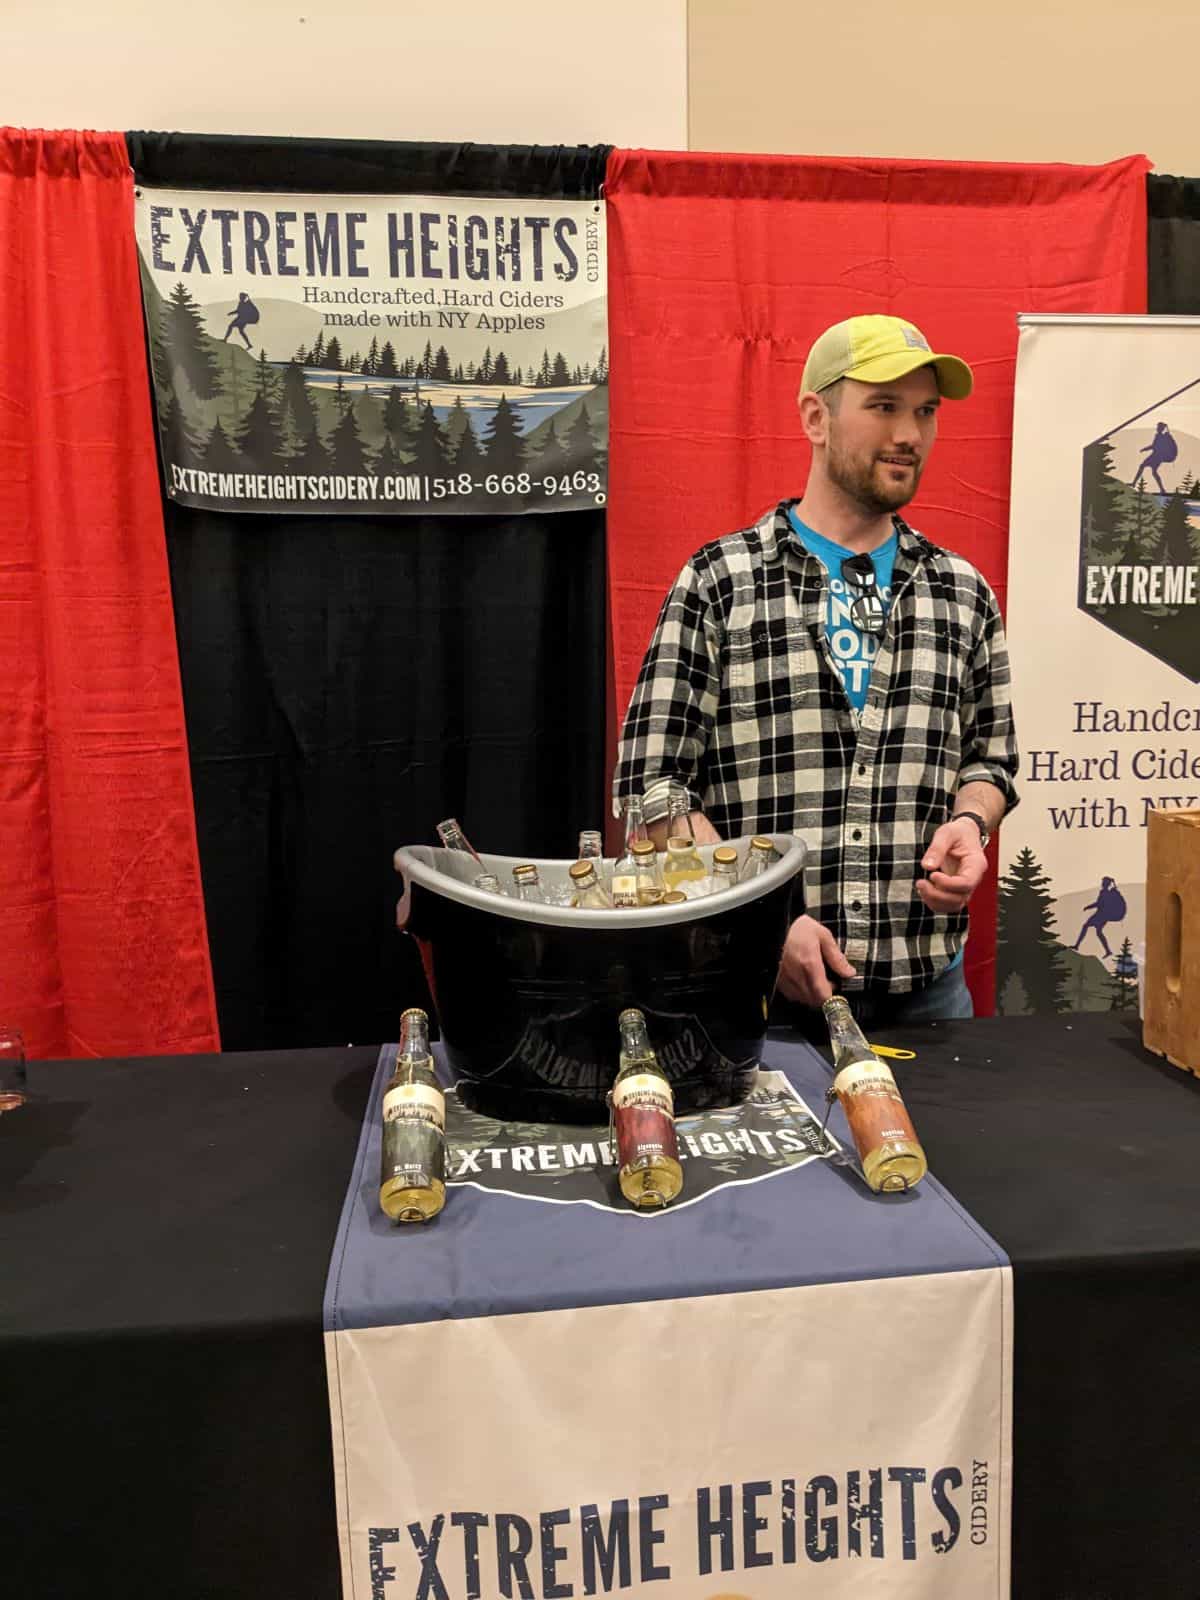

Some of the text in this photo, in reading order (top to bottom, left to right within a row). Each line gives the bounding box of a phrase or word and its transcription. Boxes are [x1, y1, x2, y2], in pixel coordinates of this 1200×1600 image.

[150, 205, 579, 283] EXTREME HEIGHTS
[586, 217, 599, 283] CIDERY
[442, 288, 494, 307] Hard
[499, 290, 565, 308] Ciders
[323, 309, 546, 334] made with NY Apples
[171, 463, 421, 501] EXTREMEHEIGHTSCIDERY.COM
[432, 470, 601, 498] 518-668-9463
[1085, 564, 1199, 605] EXTREME
[1027, 749, 1120, 782] Hard
[1048, 797, 1130, 830] with
[970, 1459, 989, 1546] CIDERY
[368, 1466, 964, 1600] EXTREME HEIGHTS
